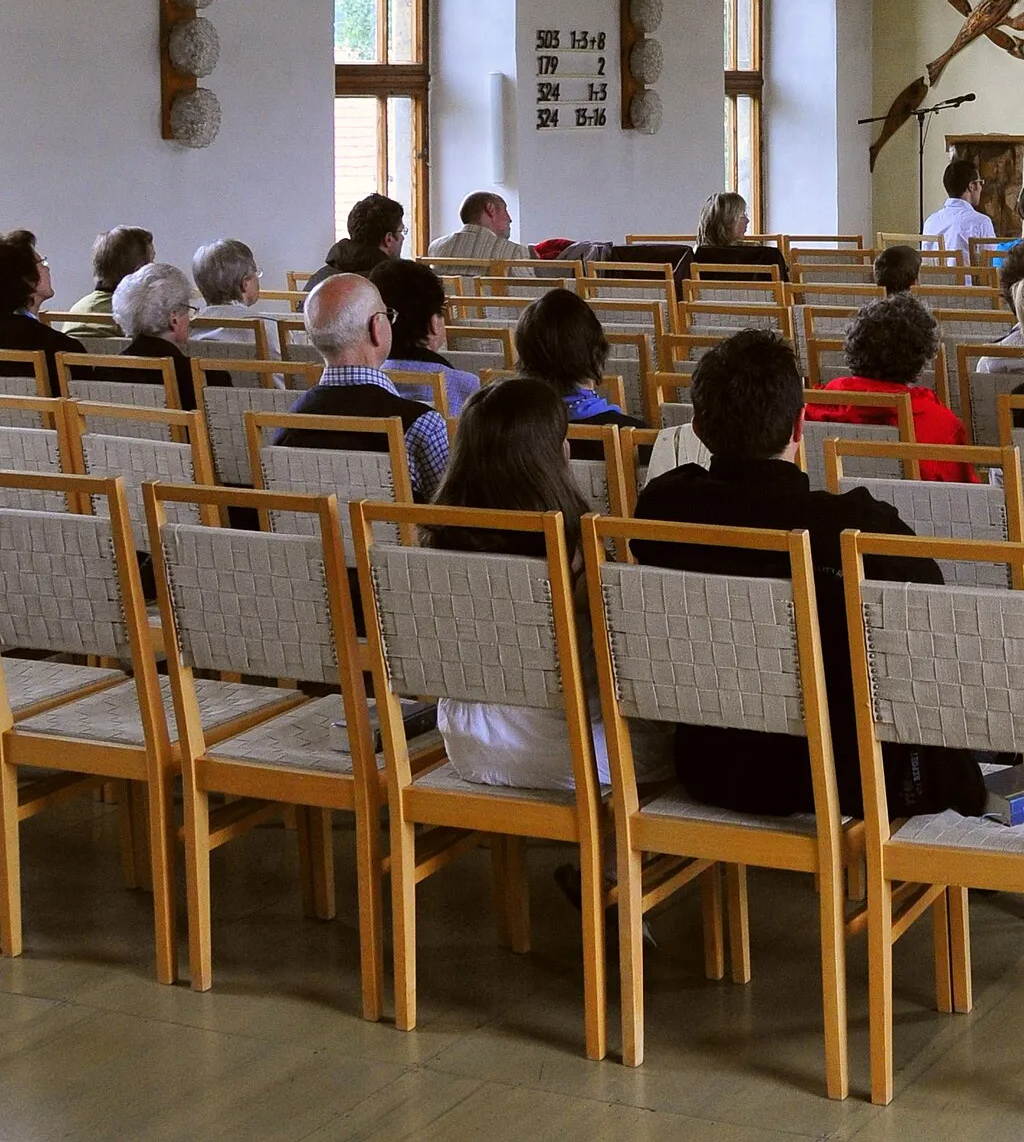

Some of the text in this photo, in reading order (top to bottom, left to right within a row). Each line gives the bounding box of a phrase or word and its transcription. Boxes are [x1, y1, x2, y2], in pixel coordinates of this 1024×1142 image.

[536, 30, 560, 49] 503
[537, 55, 606, 75] 179 2
[537, 82, 608, 102] 324 1-3
[536, 108, 607, 128] 324 13-16
